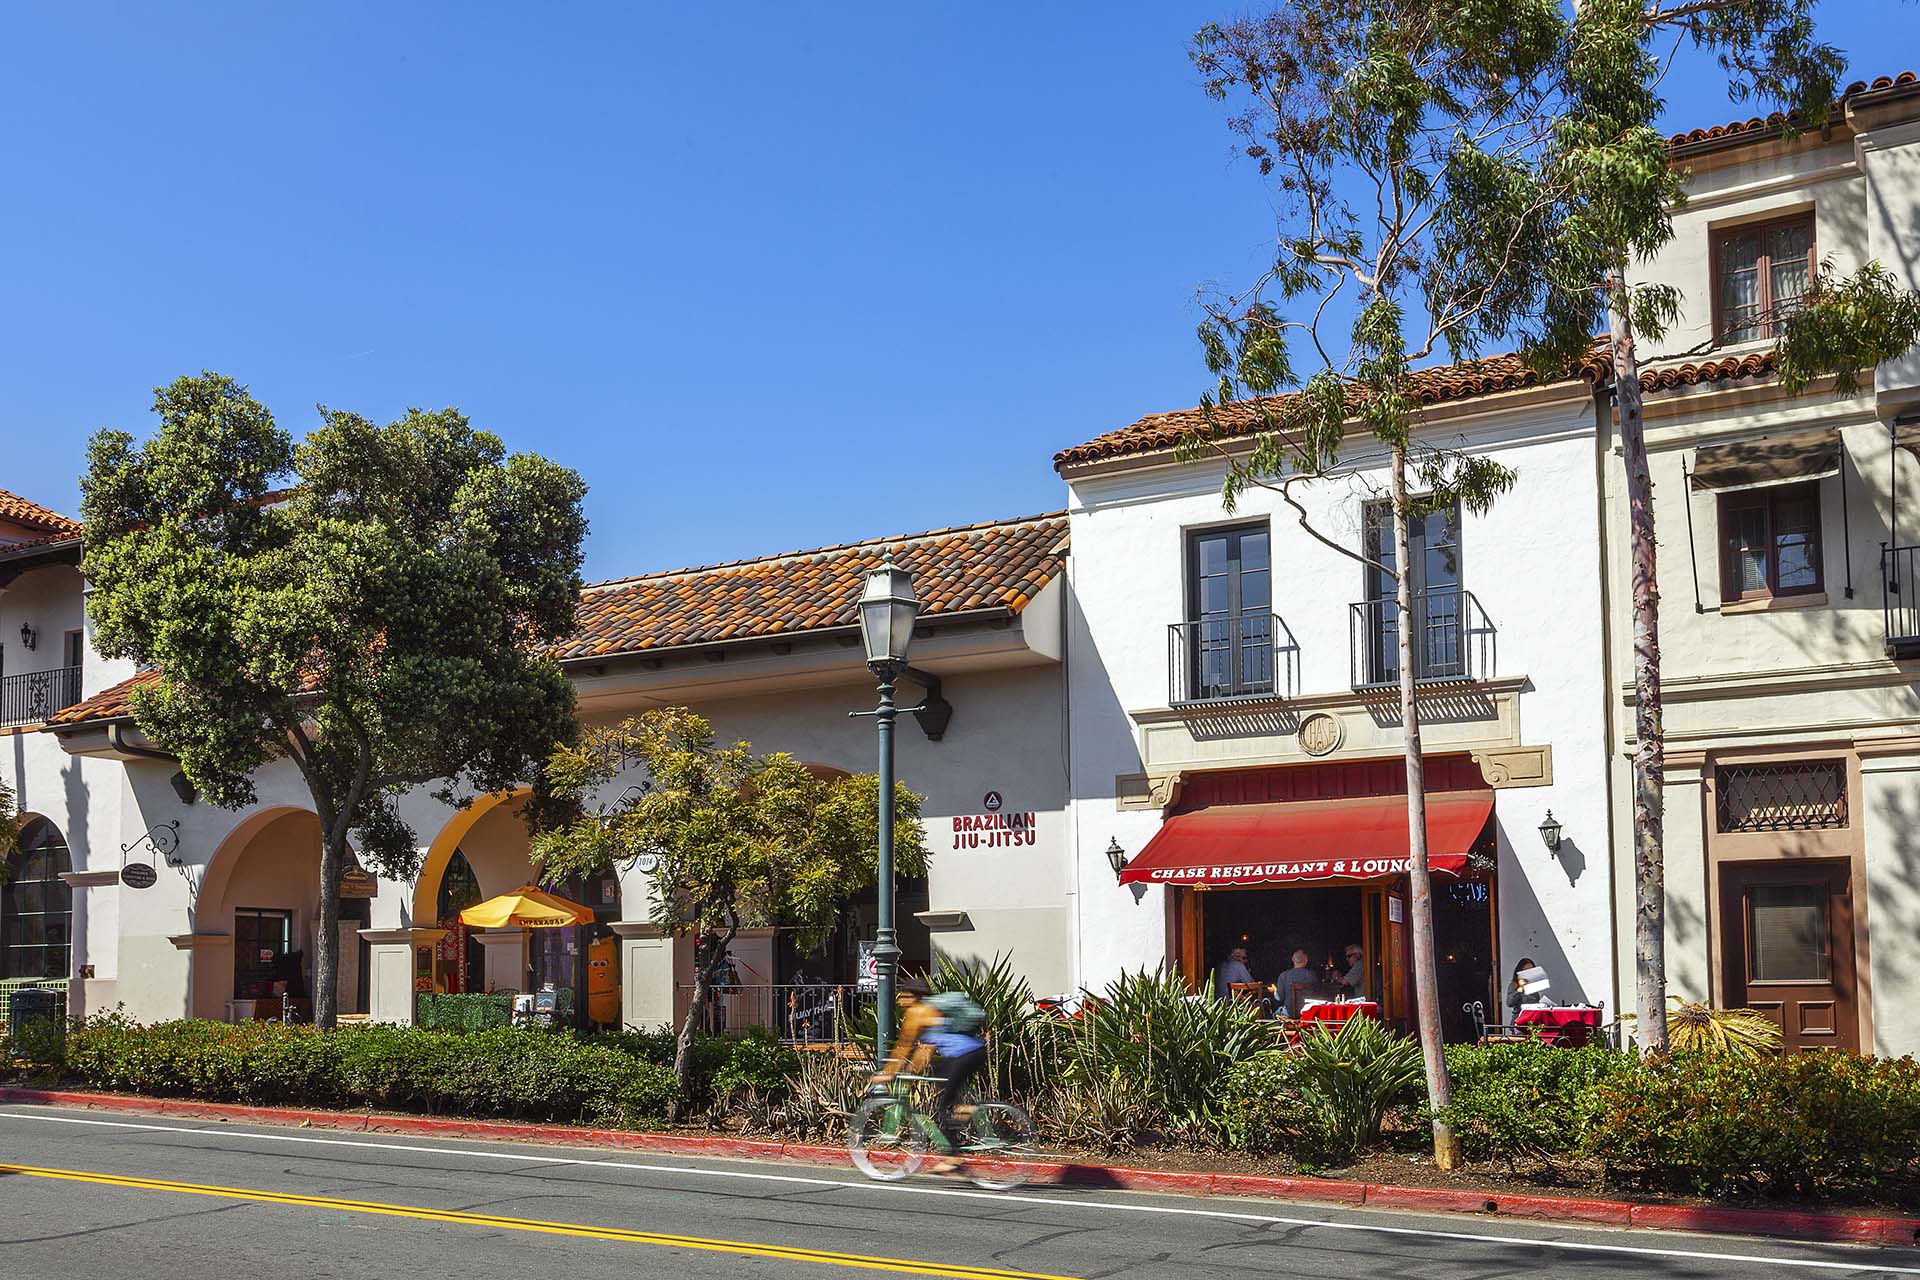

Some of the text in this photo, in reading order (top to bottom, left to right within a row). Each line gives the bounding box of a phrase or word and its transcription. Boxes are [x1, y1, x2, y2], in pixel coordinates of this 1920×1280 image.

[953, 812, 1036, 832] BRAZILIAN
[953, 830, 1036, 849] JIU-JITSU
[638, 857, 653, 866] 1014
[1151, 858, 1429, 879] CHASE RESTAURANT & LOUN
